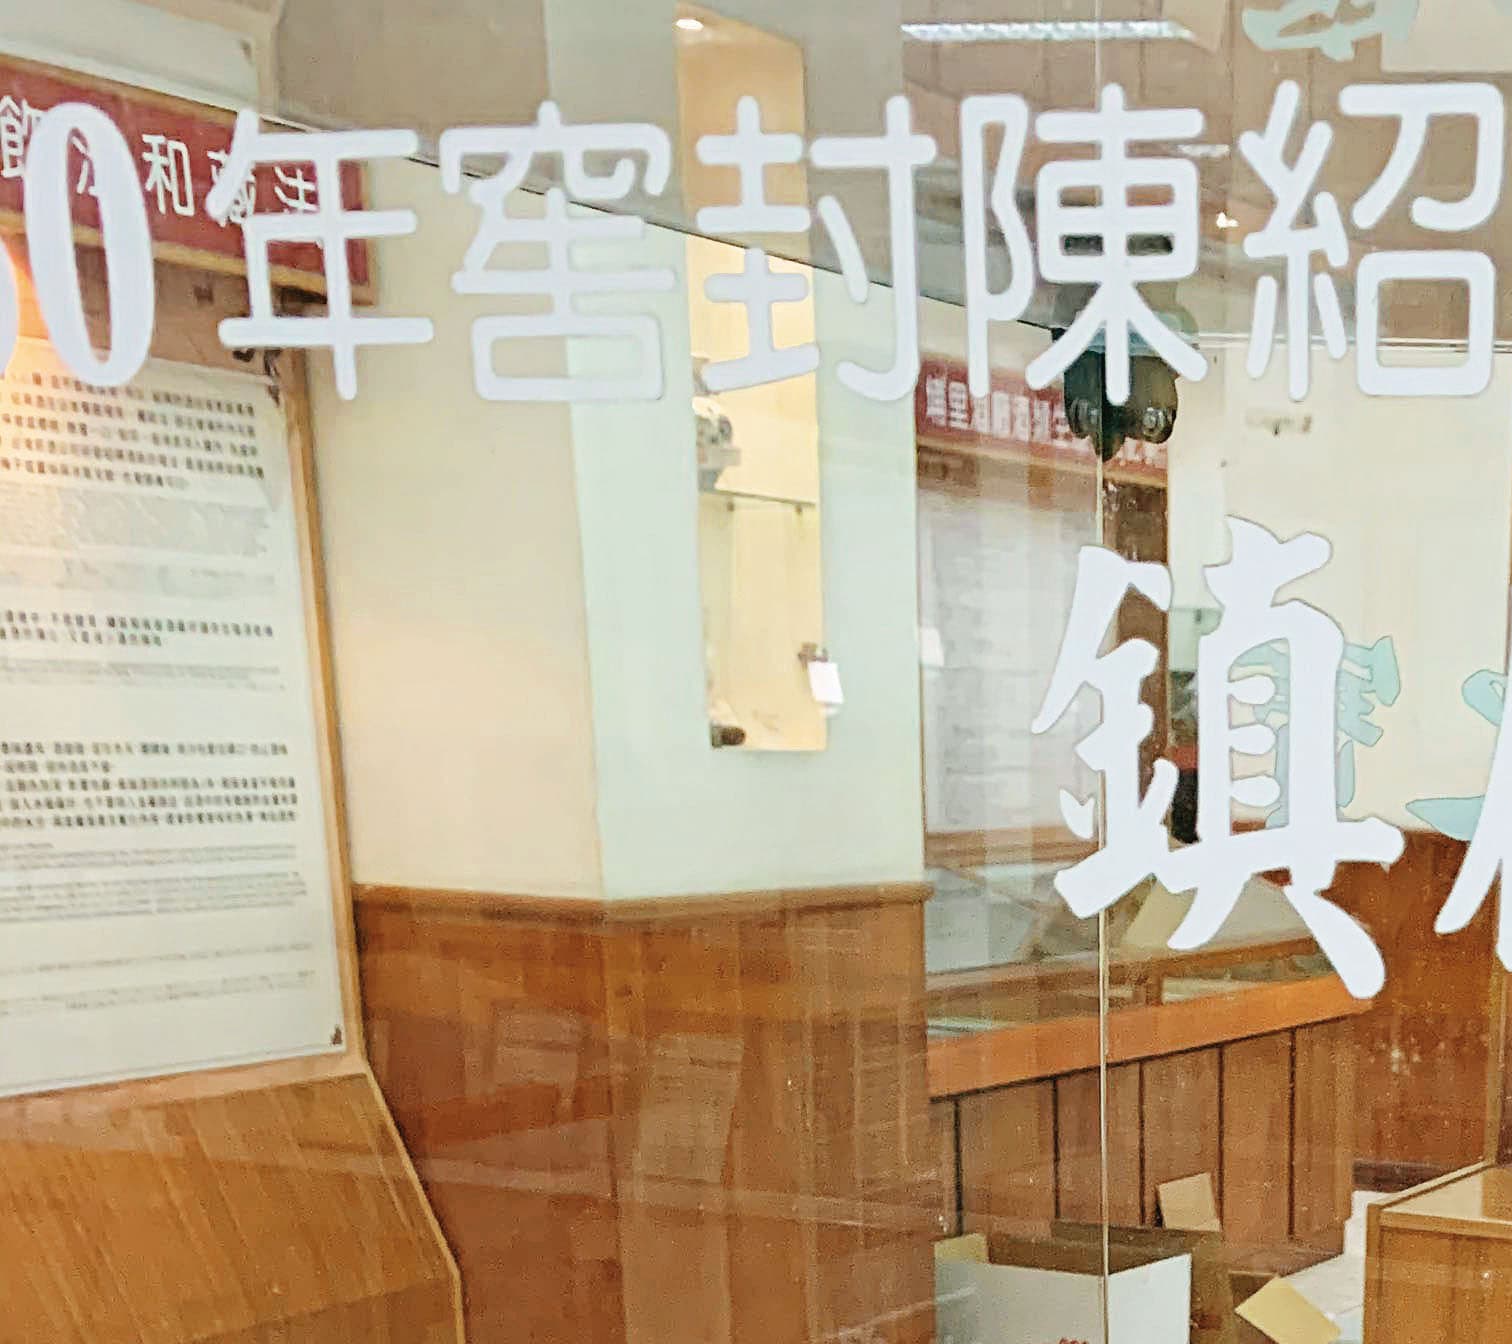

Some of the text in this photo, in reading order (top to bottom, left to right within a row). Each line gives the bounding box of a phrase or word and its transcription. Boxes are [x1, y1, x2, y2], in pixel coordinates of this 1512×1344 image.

[0, 82, 1503, 403] 0年窖封陳紹
